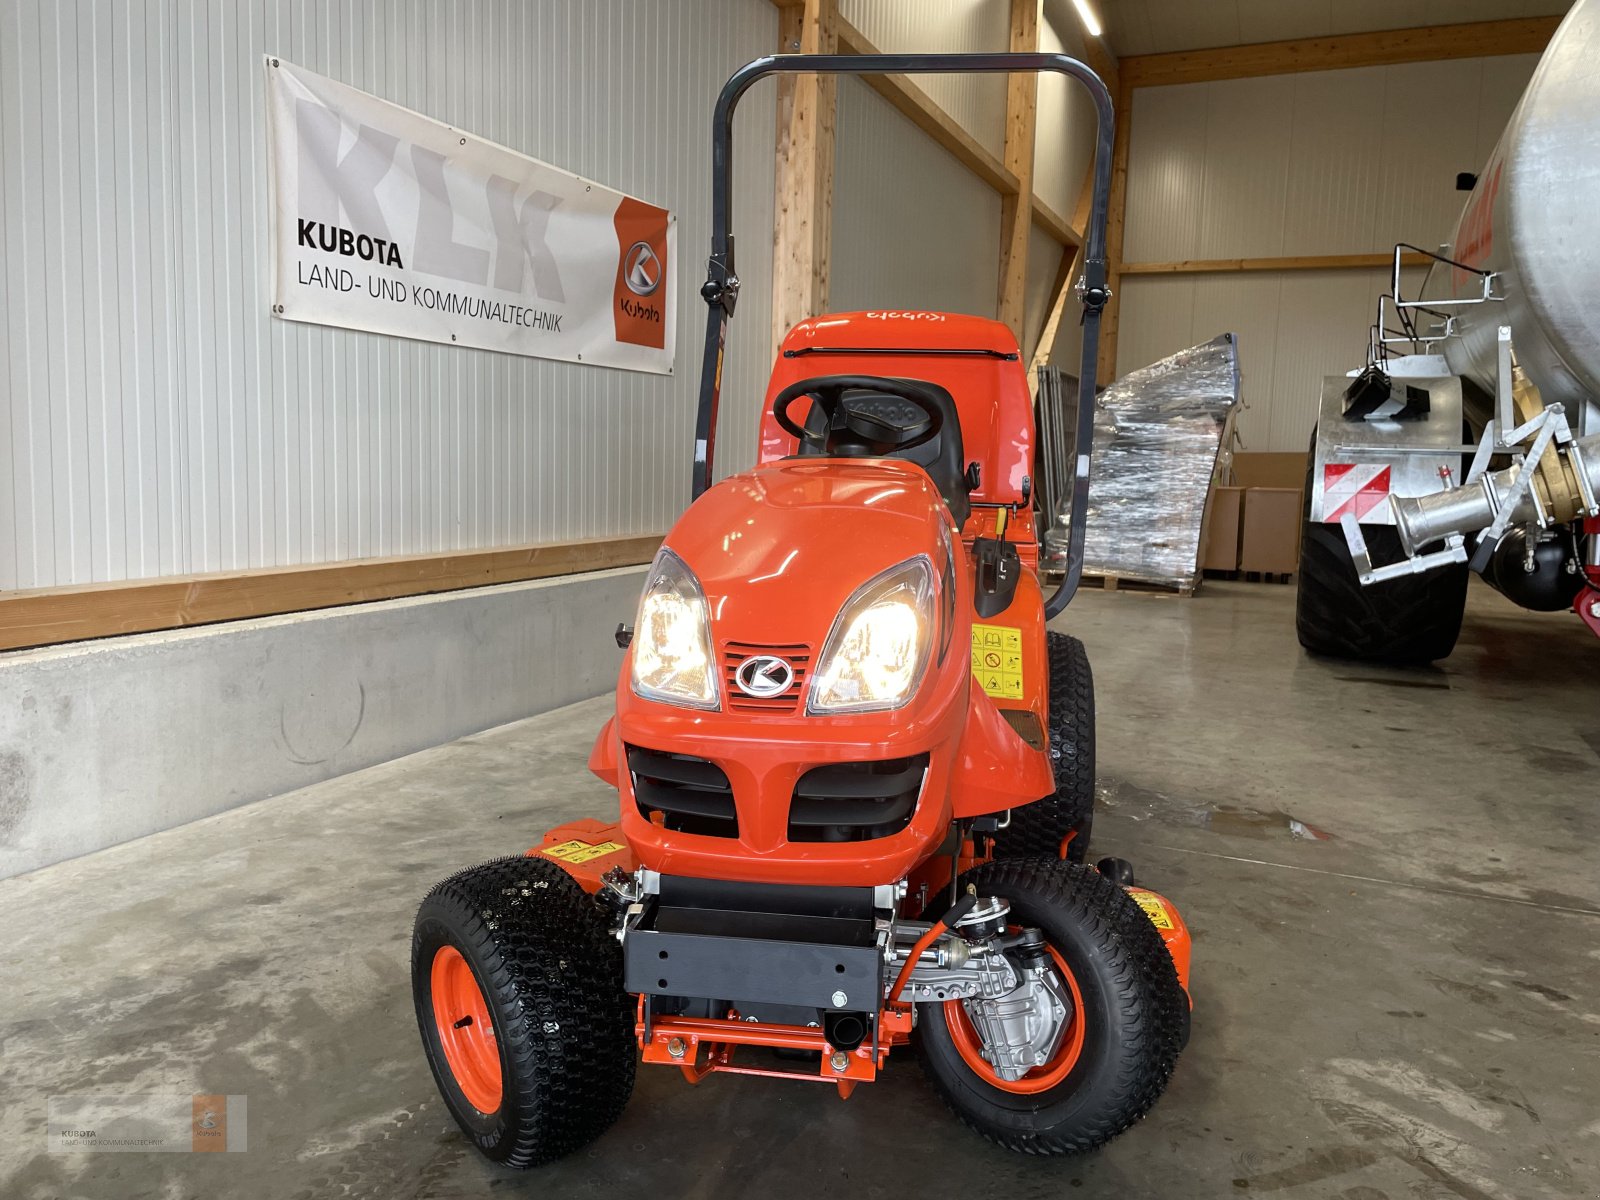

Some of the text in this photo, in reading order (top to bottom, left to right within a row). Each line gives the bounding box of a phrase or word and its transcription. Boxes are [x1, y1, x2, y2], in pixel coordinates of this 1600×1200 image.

[297, 217, 404, 270] KUBOTA
[298, 260, 563, 333] LAND- UND KOMMUNALTECHNIK
[620, 297, 660, 323] Kubota
[866, 312, 945, 321] Kubota
